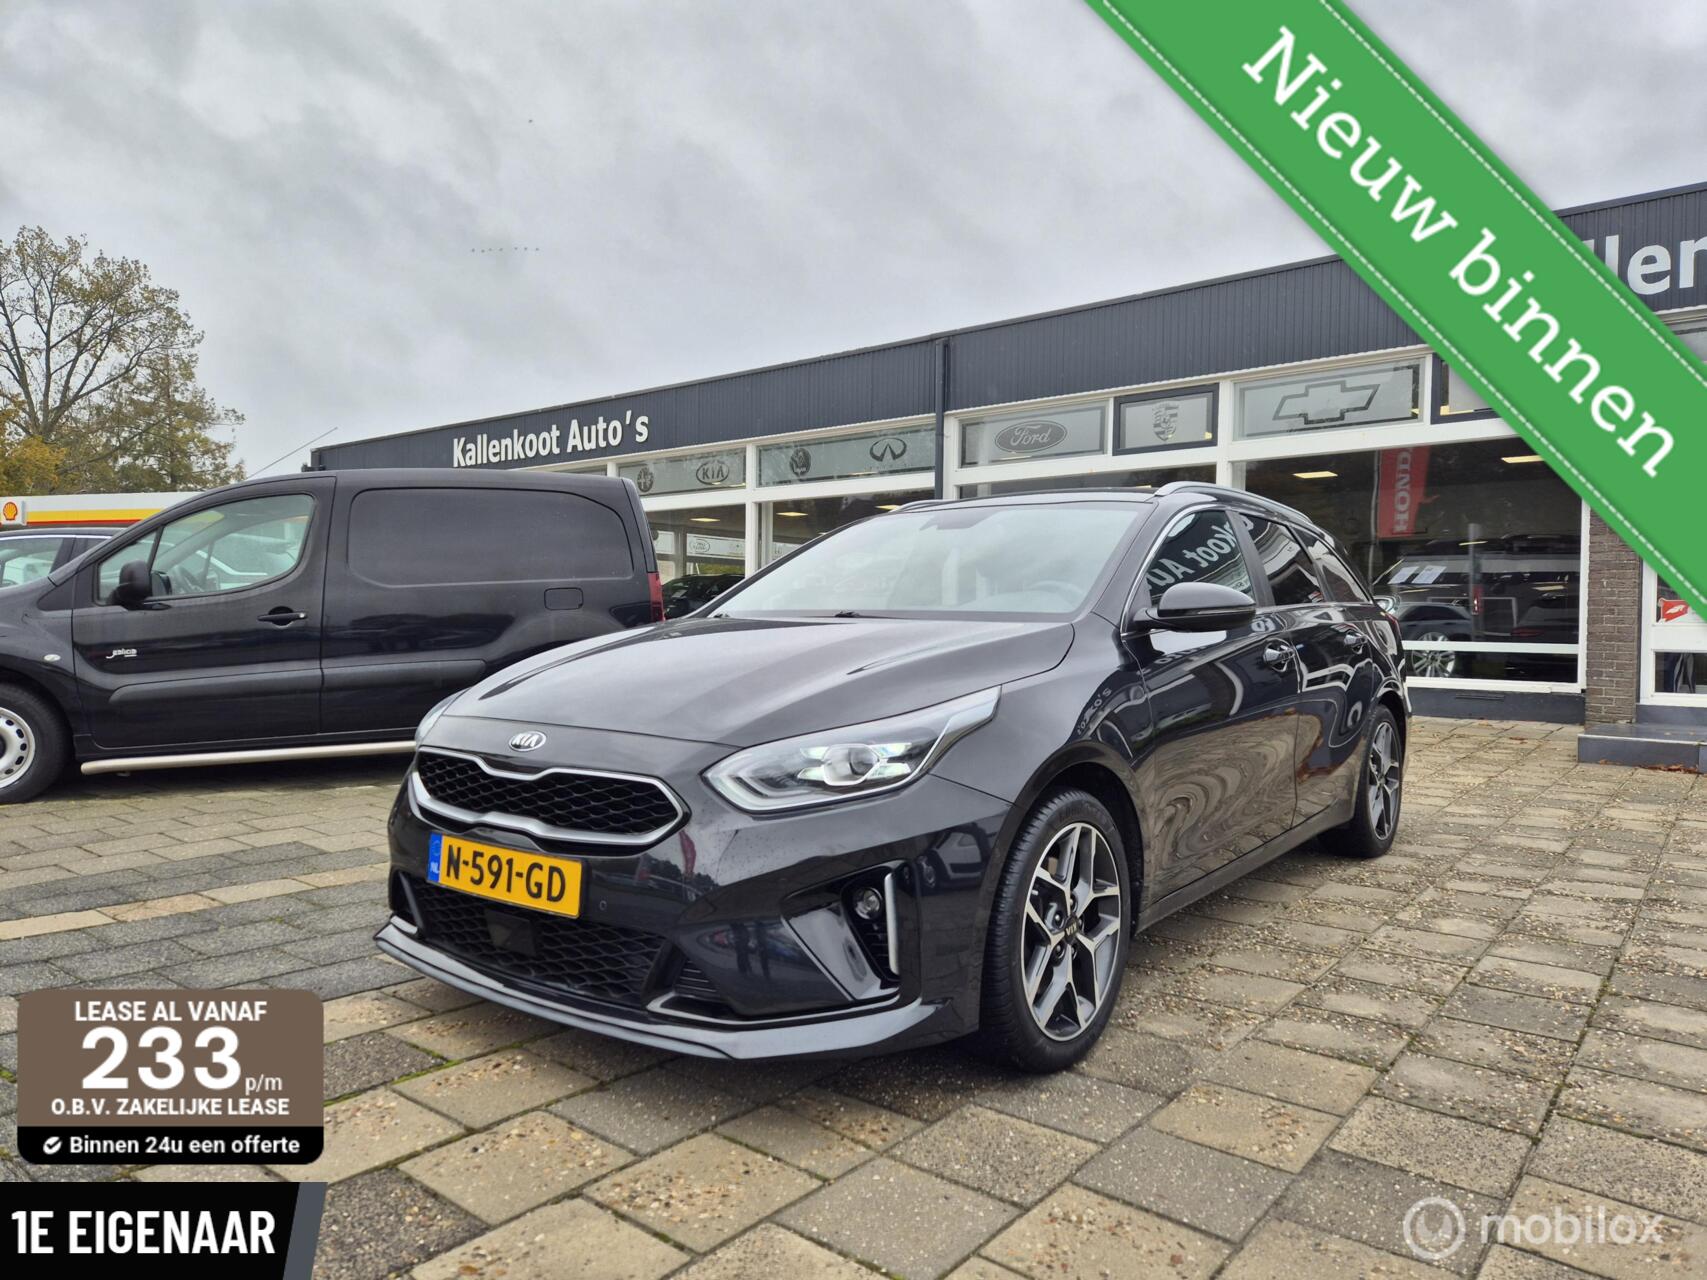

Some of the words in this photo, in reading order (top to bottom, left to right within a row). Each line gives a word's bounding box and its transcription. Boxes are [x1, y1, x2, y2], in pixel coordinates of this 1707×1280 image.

[453, 424, 560, 468] Kallenkoot
[566, 410, 649, 453] Auto's
[1010, 425, 1052, 446] Ford
[702, 464, 725, 480] KIA
[511, 732, 537, 748] KIA
[430, 861, 440, 874] NL
[446, 844, 566, 903] N-591-GD
